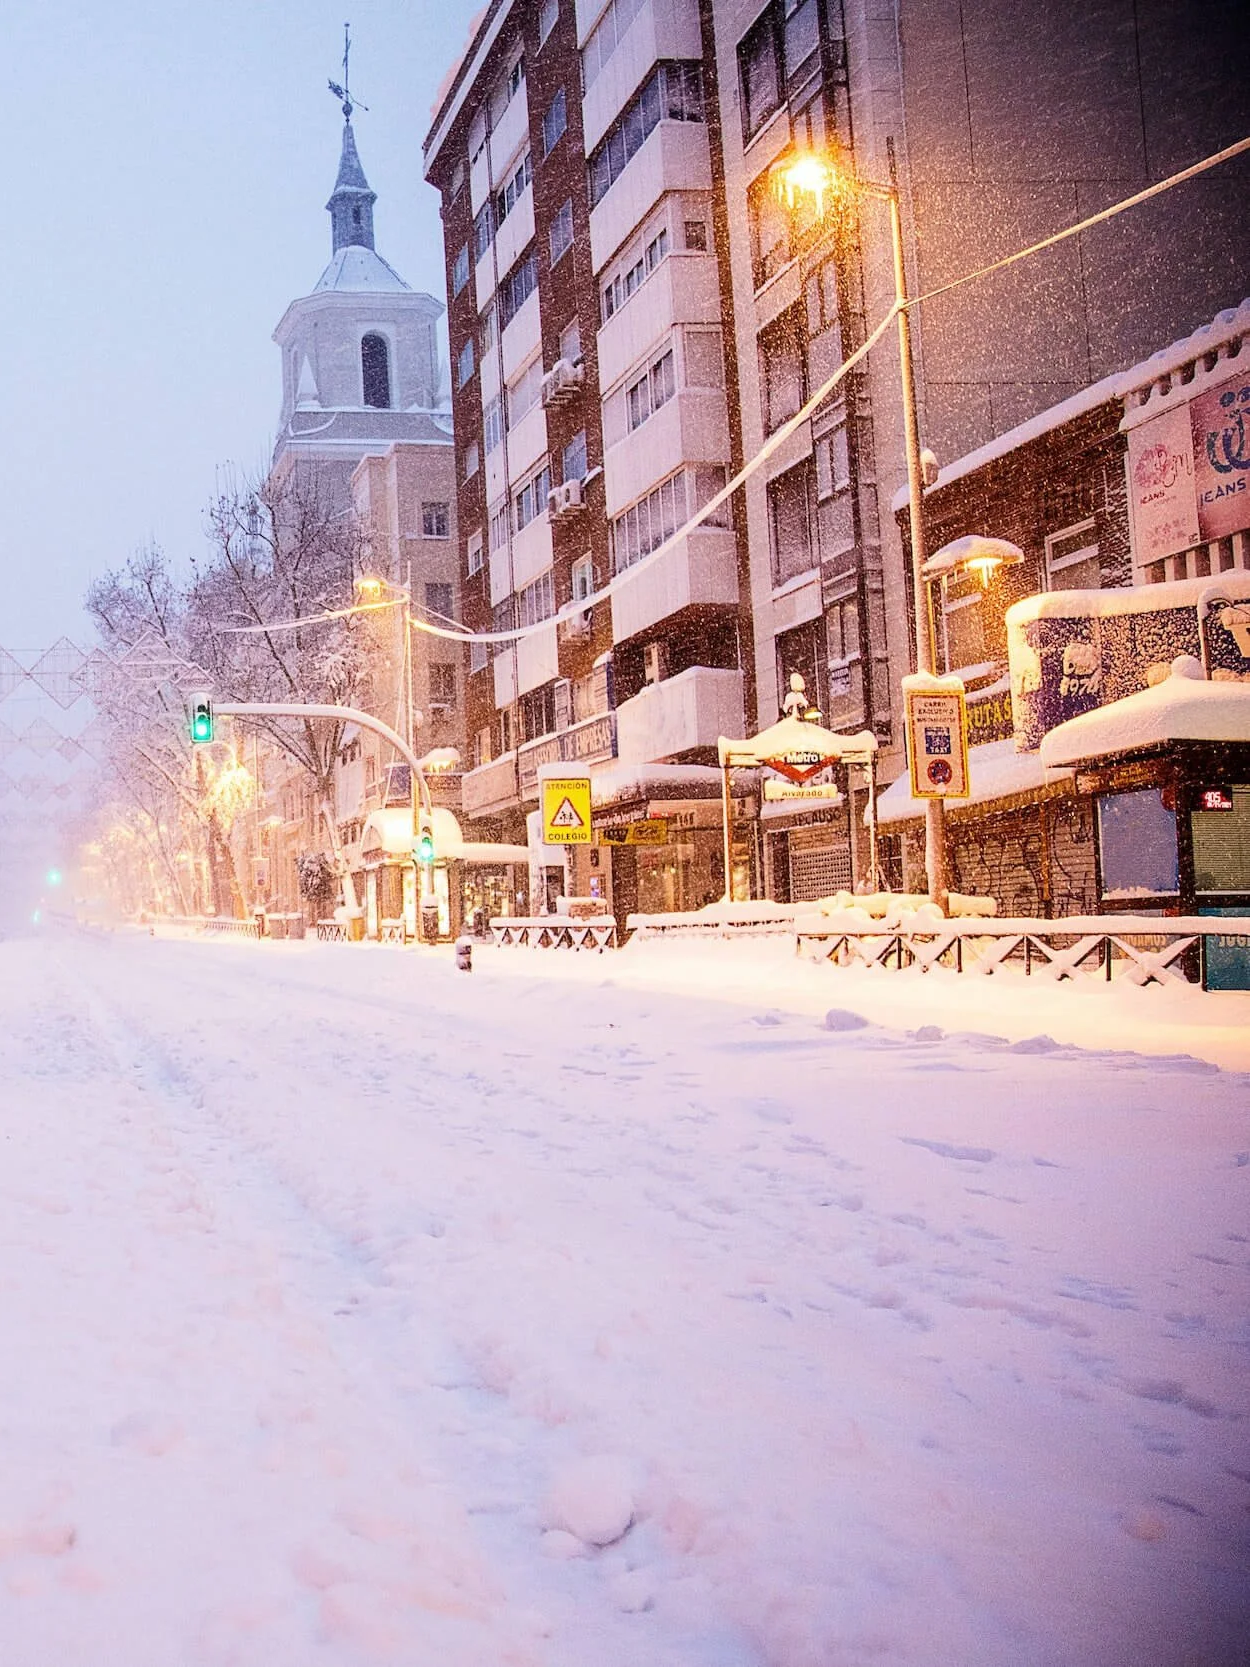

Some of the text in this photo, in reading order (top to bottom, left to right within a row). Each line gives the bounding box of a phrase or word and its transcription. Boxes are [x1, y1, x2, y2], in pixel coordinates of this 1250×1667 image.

[1199, 477, 1247, 507] JEANS
[785, 751, 820, 765] Metro
[548, 832, 588, 841] COLEGIO
